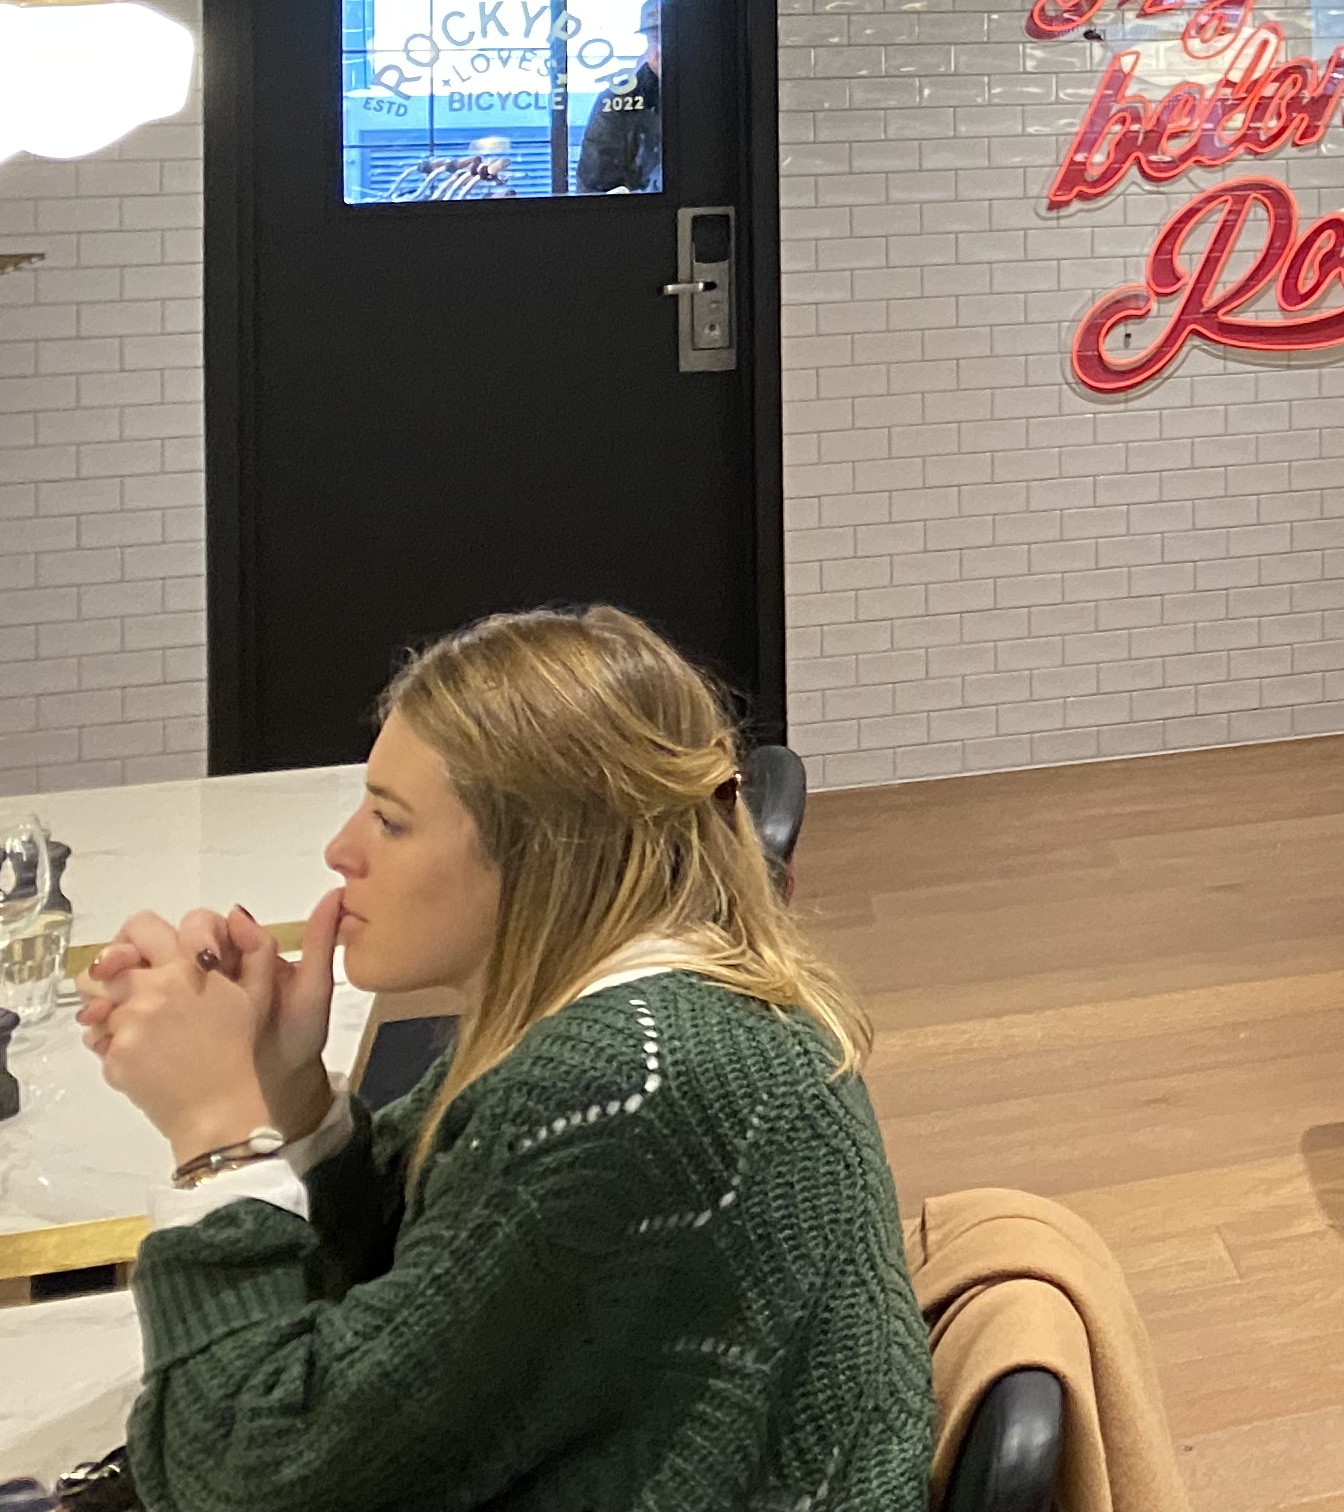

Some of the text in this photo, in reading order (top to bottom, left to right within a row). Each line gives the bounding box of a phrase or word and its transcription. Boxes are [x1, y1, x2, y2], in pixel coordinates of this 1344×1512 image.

[370, 1, 638, 99] ROCKYPOP
[453, 50, 558, 82] LOVES
[362, 97, 407, 117] ESTD
[448, 90, 565, 112] BICYCLE
[601, 96, 645, 112] 2022
